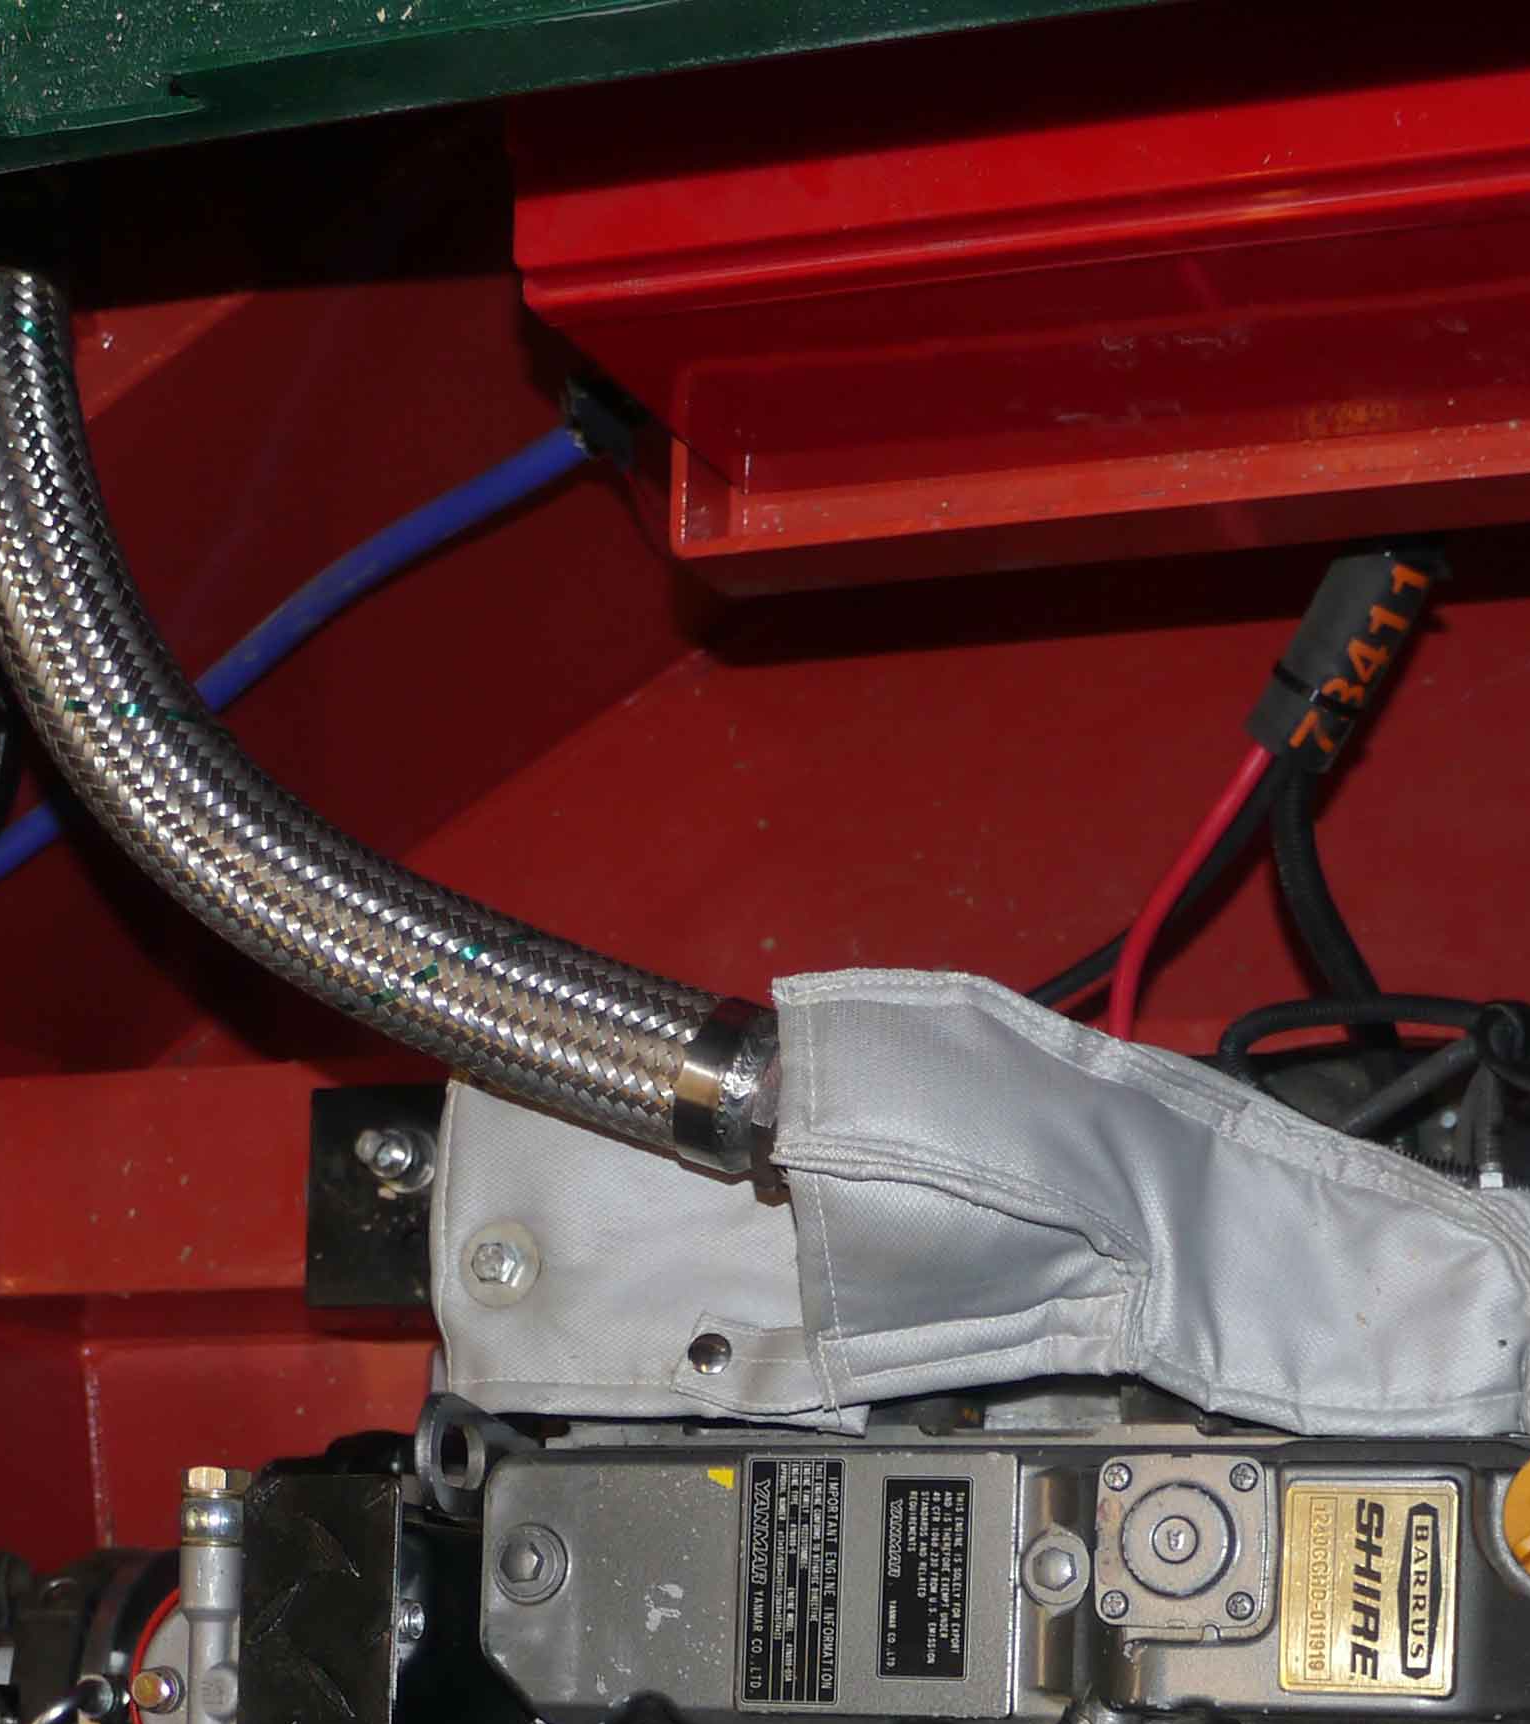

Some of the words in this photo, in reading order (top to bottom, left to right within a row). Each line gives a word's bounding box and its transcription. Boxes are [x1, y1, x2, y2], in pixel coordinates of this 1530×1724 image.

[825, 1476, 839, 1544] IMPORTANT
[919, 1491, 929, 1537] STANDARDS
[931, 1506, 939, 1522] CFR
[944, 1491, 952, 1507] AND
[955, 1492, 965, 1513] THIS
[751, 1479, 770, 1584] YANMAR
[907, 1490, 917, 1553] REQUIREMENTS
[943, 1512, 951, 1522] IS
[954, 1517, 964, 1548] ENGINE
[887, 1498, 903, 1577] YANMAR
[918, 1541, 927, 1558] AND
[941, 1527, 951, 1573] THEREFORE
[953, 1553, 963, 1564] IS
[823, 1552, 837, 1597] ENGINE
[917, 1561, 926, 1598] RELATED
[928, 1572, 937, 1593] FROM
[953, 1567, 962, 1598] SOLELY
[1350, 1498, 1385, 1681] SHIRE
[940, 1577, 949, 1608] EXEMPT
[1410, 1524, 1429, 1659] BARRUS
[752, 1591, 764, 1632] YANMAR
[888, 1600, 897, 1628] YANMAR
[939, 1613, 948, 1638] UNDER
[952, 1602, 961, 1618] FOR
[821, 1607, 836, 1690] INFORMATION
[926, 1622, 936, 1664] EMISSION
[951, 1623, 960, 1654] EXPORT
